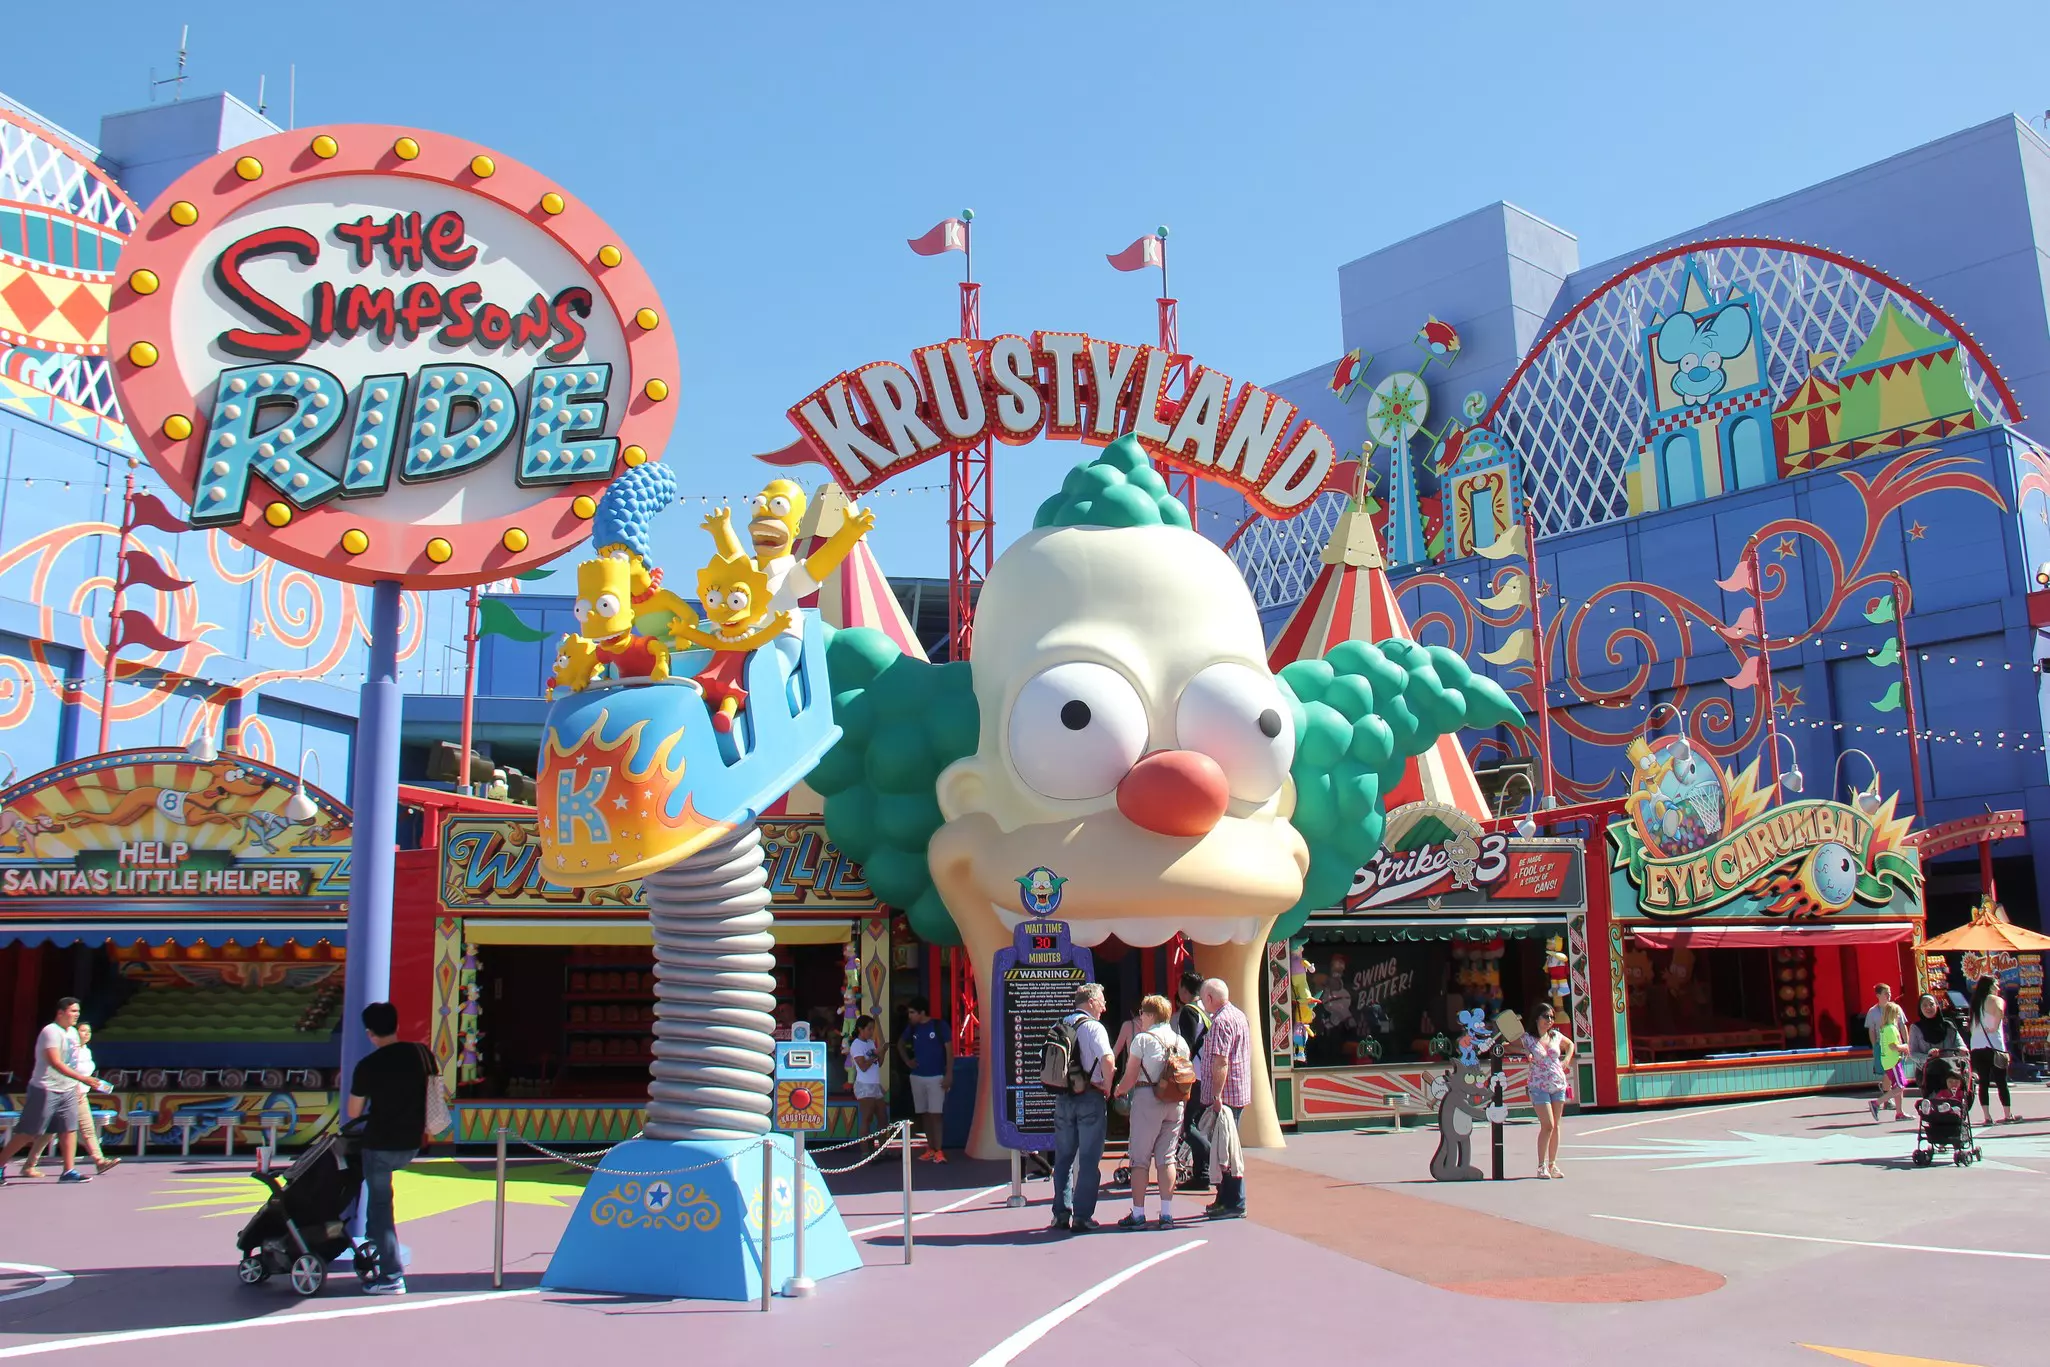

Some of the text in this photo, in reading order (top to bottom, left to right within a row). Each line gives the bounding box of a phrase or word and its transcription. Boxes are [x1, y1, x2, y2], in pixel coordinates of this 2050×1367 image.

[944, 222, 963, 247] K
[1143, 238, 1160, 263] K
[213, 226, 593, 363] SIMPSONS
[790, 332, 1337, 512] KRUSTYLAND
[191, 362, 621, 530] RIDE
[556, 766, 612, 845] K
[119, 841, 189, 868] HELP
[1347, 834, 1507, 896] Strike 3
[1645, 806, 1870, 907] EYE CARUMBA!
[3, 868, 301, 894] SANTA'S LITTLE HELPER
[1519, 865, 1538, 878] FOOL
[1534, 878, 1558, 894] CANS!
[1024, 923, 1063, 934] WAIT TIME
[1035, 936, 1051, 949] 30
[1029, 953, 1061, 963] MINUTES
[1019, 970, 1070, 979] WARNING
[1353, 957, 1397, 991] SWING
[1357, 969, 1414, 1010] BATTER!
[781, 1113, 821, 1124] KRUSTYLAND
